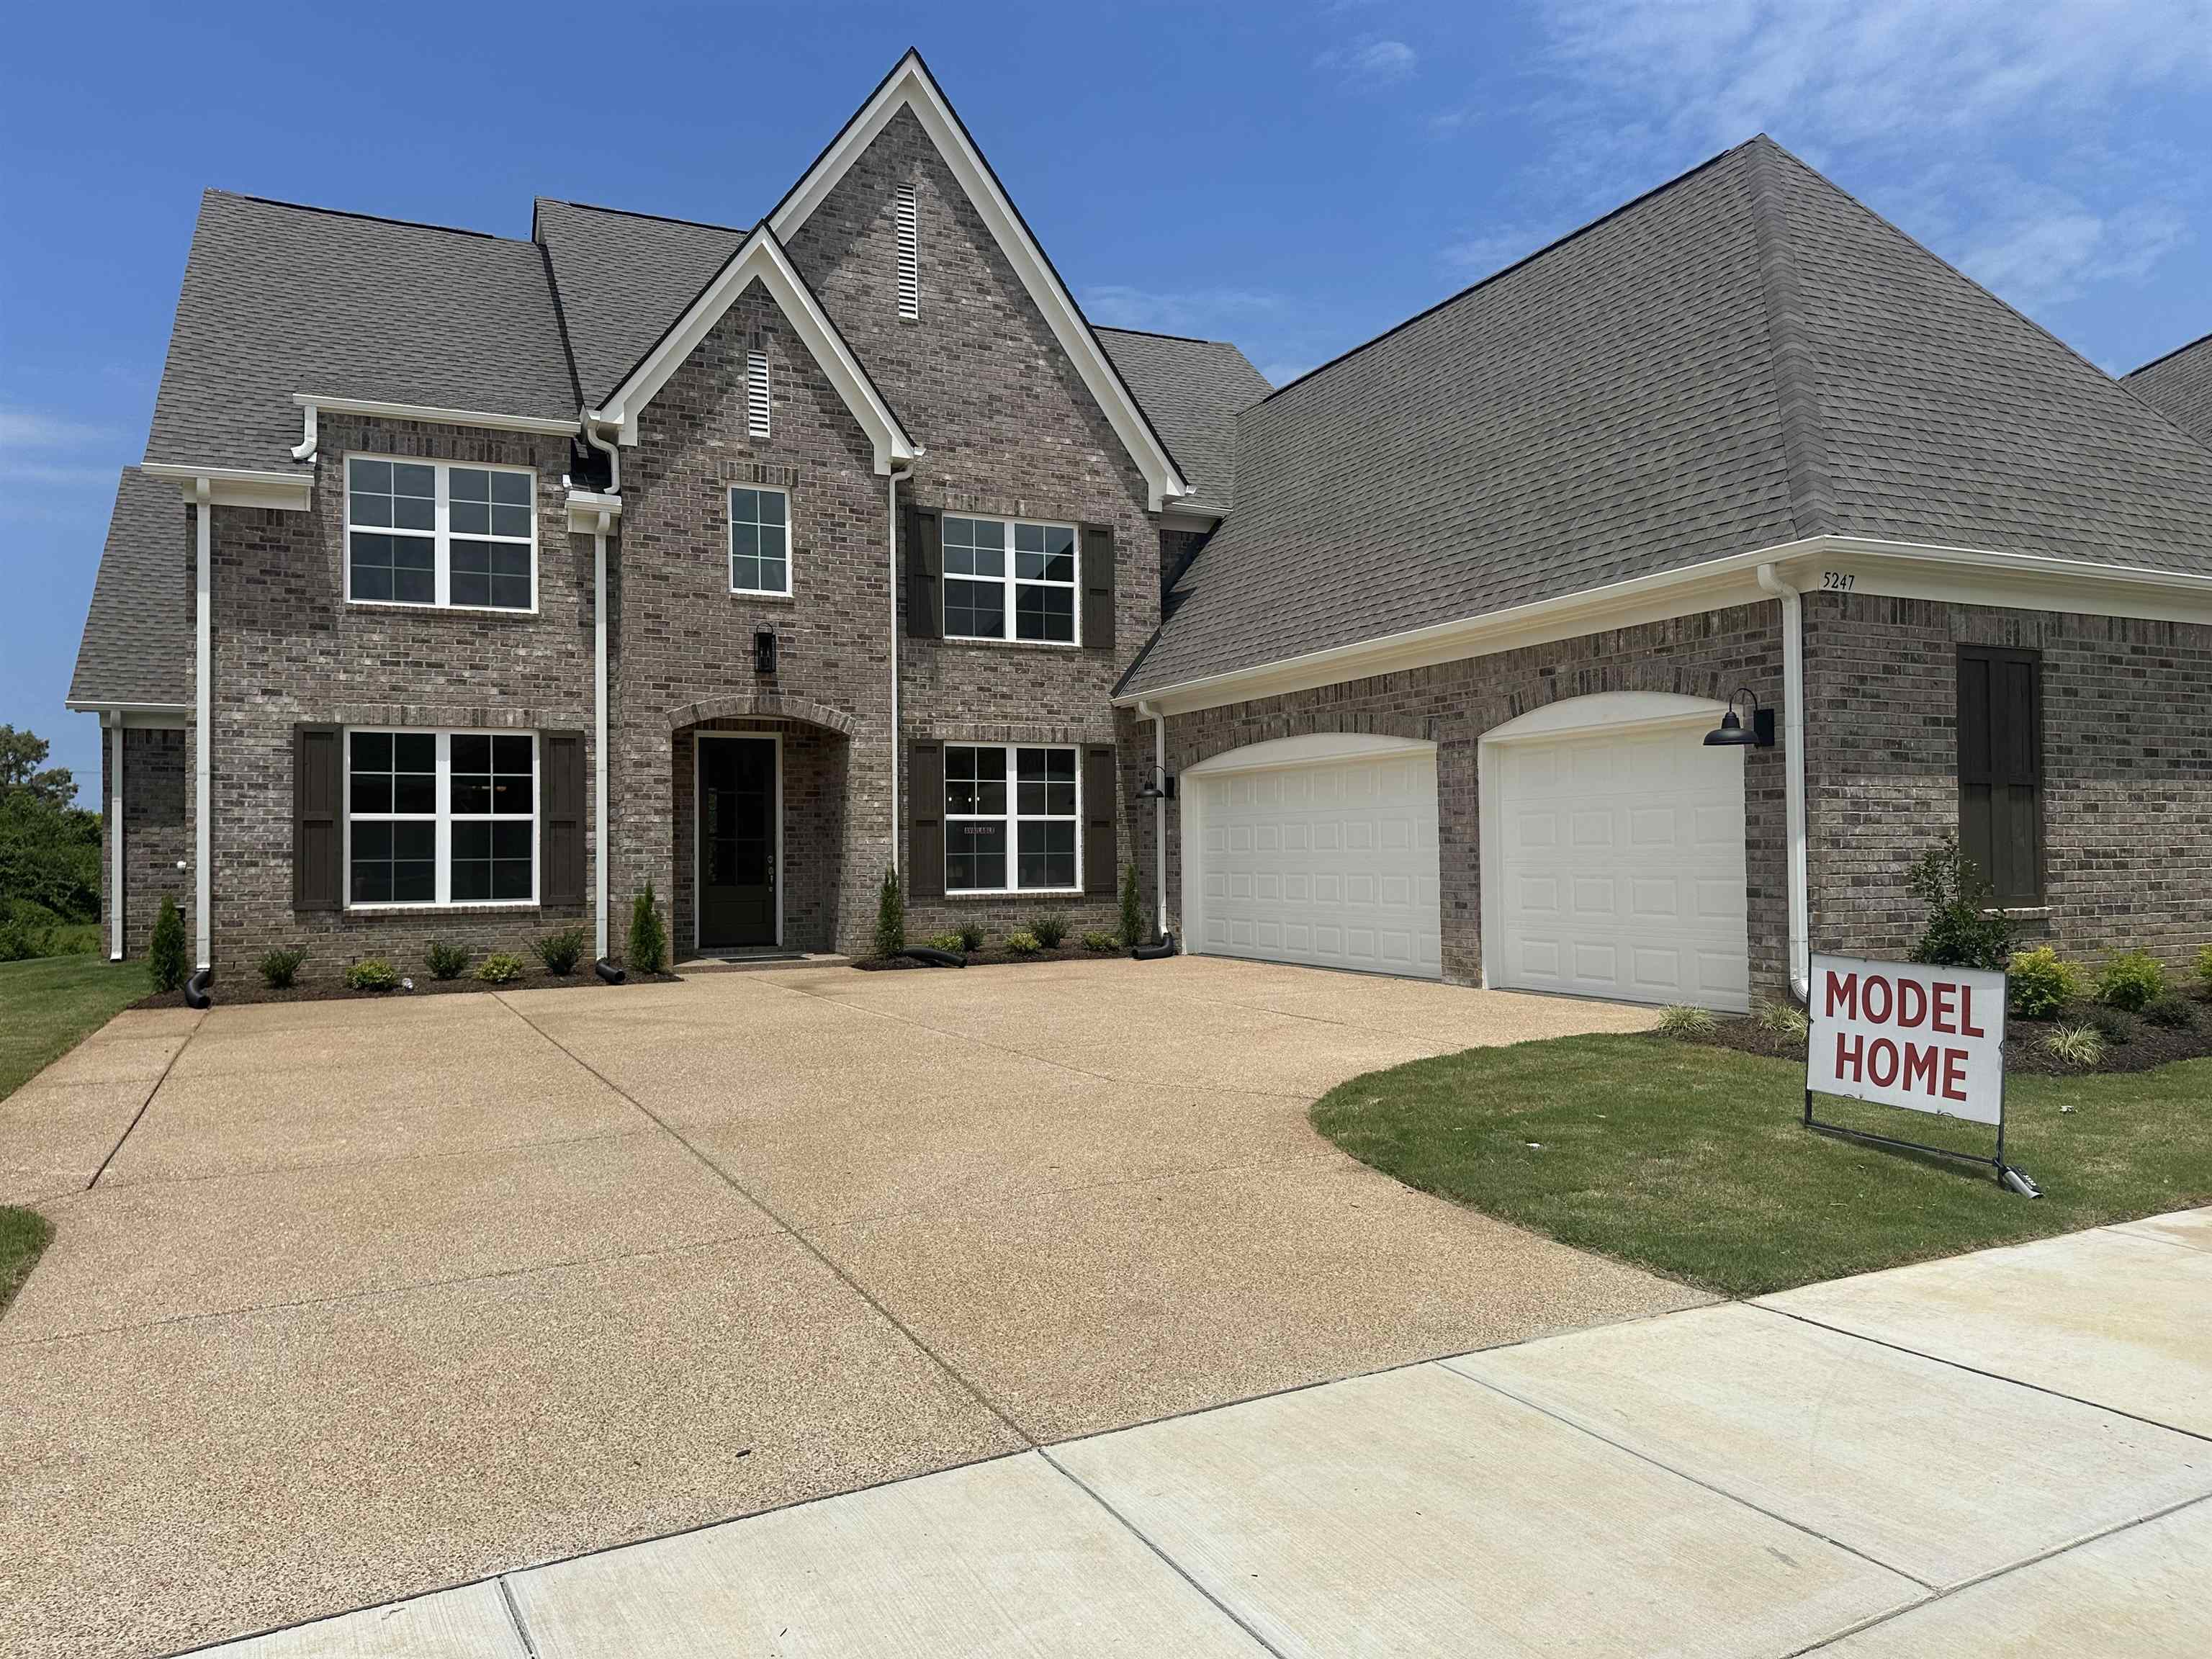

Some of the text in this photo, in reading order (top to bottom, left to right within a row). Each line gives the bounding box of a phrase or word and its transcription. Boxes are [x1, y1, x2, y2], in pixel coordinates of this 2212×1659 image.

[1823, 572, 1855, 590] 5247
[1826, 971, 1984, 1038] MODEL
[1835, 1033, 1969, 1102] HOME
